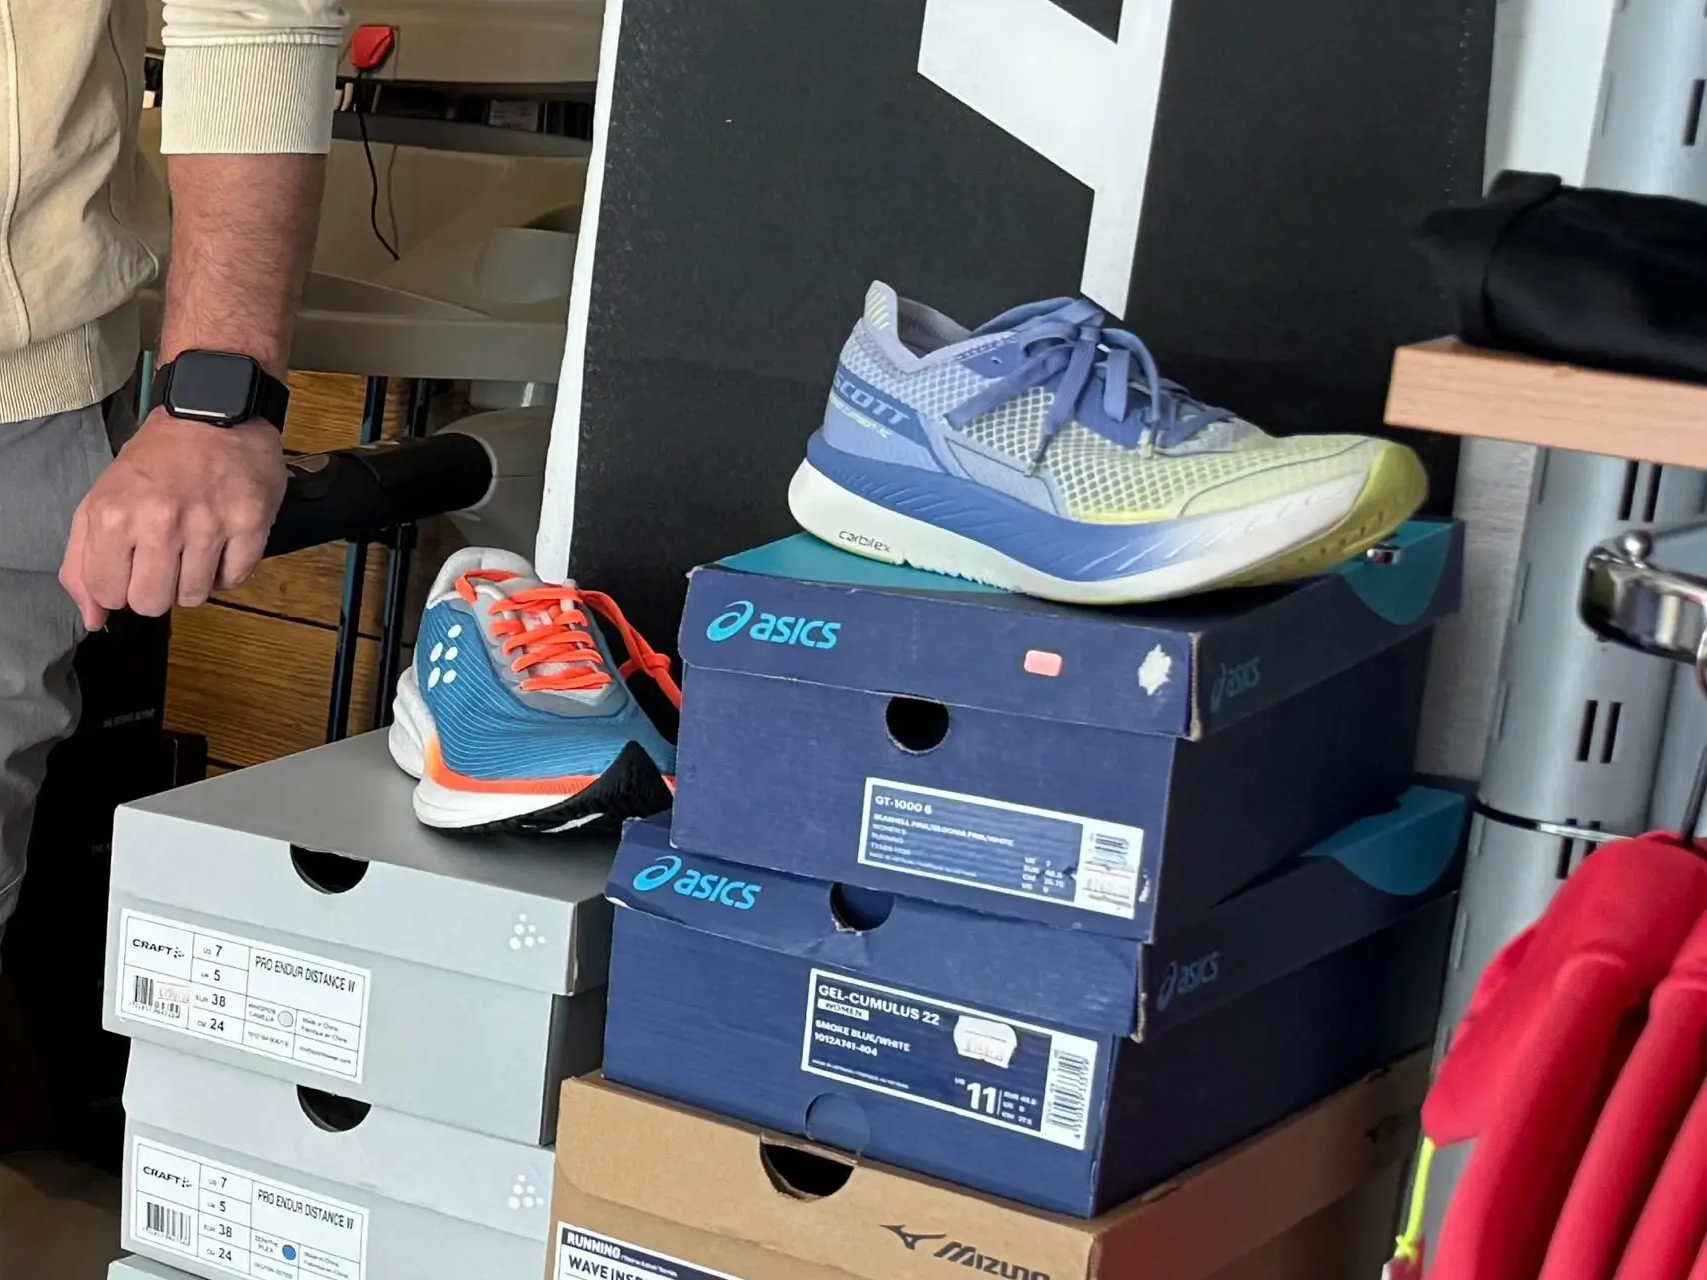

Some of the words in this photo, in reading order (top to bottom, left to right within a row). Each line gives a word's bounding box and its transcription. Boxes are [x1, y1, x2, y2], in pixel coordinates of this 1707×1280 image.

[831, 372, 910, 426] SCOTT
[749, 612, 841, 650] asics
[875, 796, 922, 813] GT-1000
[671, 866, 762, 911] asics
[133, 938, 172, 955] CRAFT
[255, 956, 273, 971] PRO
[275, 960, 303, 978] ENDUR
[306, 968, 346, 990] DISTANCE
[212, 994, 226, 1007] 38
[819, 984, 919, 1020] GEL-CUMULUS
[922, 1010, 940, 1026] 22
[210, 1018, 224, 1032] 24
[816, 1020, 850, 1036] SMOKE
[851, 1028, 911, 1052] BLUE/WHITE
[967, 1082, 997, 1114] 11
[143, 1166, 180, 1184] CRAFT
[258, 1189, 273, 1204] PRO
[277, 1195, 302, 1215] ENDUR
[305, 1203, 345, 1227] DISTANCE
[219, 1224, 232, 1238] 38
[219, 1248, 232, 1261] 24
[566, 1232, 621, 1260] RUNNING
[568, 1254, 608, 1279] WAVE
